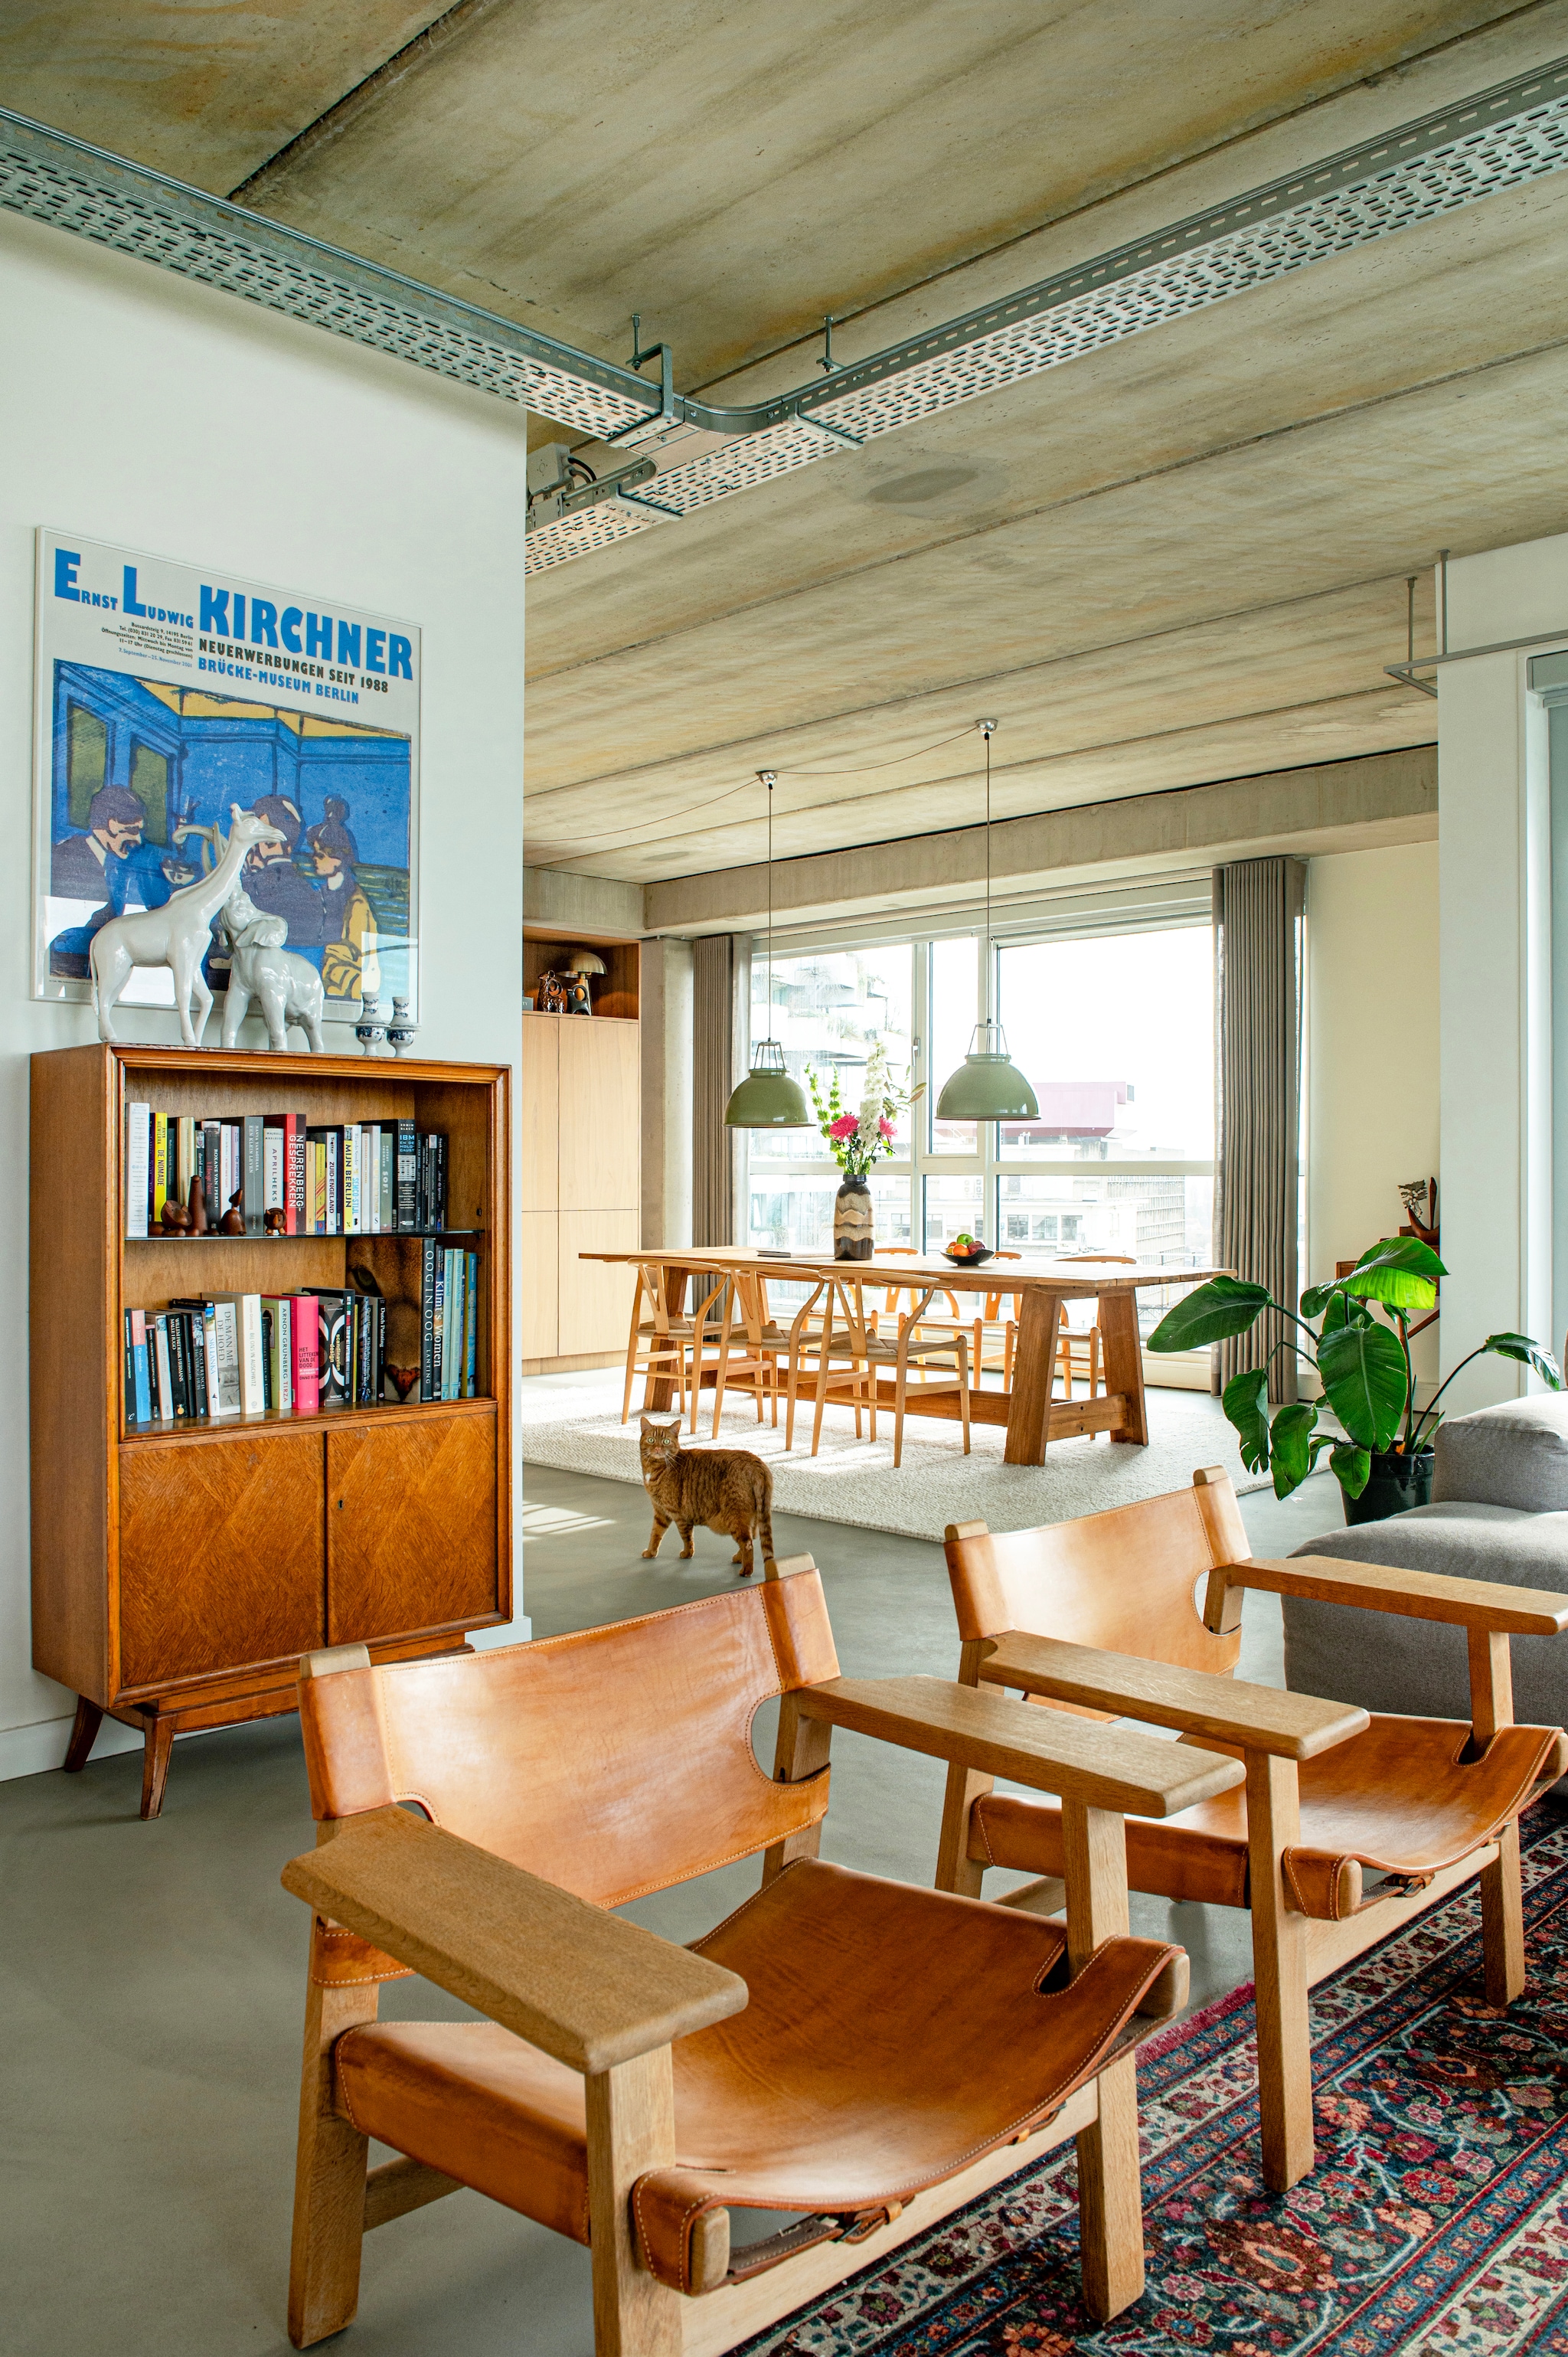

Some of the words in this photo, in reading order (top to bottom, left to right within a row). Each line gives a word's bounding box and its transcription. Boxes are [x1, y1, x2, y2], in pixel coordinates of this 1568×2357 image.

[55, 548, 118, 611] ERNST
[122, 564, 194, 629] LUDWIG
[200, 584, 413, 681] KIRCHNER
[132, 622, 159, 633] Bussardsteig
[198, 657, 311, 693] BRÜCKE-MUSEUM
[316, 684, 359, 704] BERLIN
[199, 639, 324, 678] NEUERWERBUNGEN
[329, 669, 355, 685] SEIT
[361, 676, 388, 693] 1988
[426, 1289, 433, 1303] IN
[435, 1280, 443, 1320] Klimt's
[217, 1320, 224, 1331] DE
[224, 1311, 231, 1323] DE
[424, 1309, 433, 1341] OOG
[433, 1325, 443, 1367] Women
